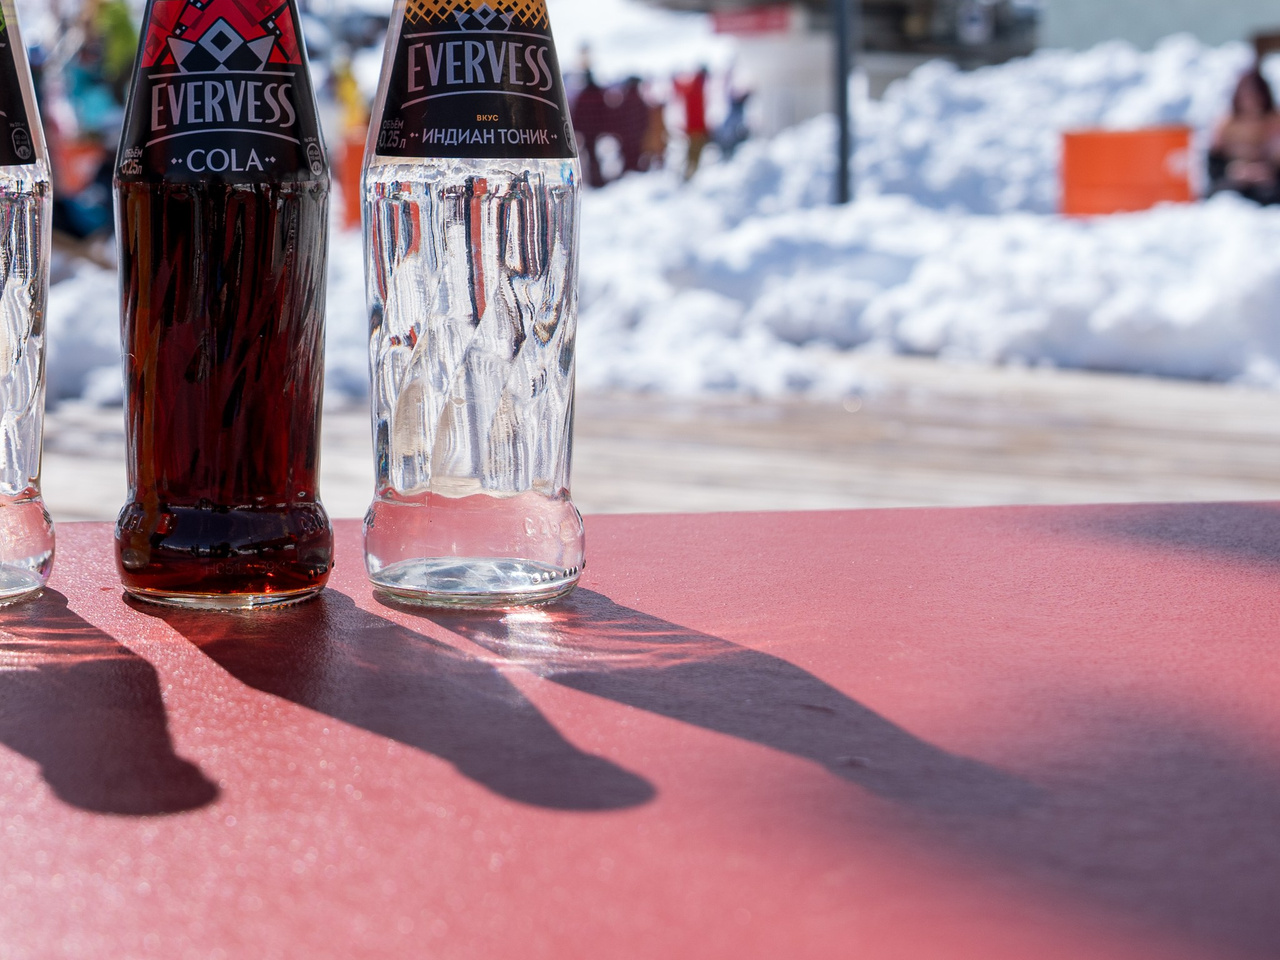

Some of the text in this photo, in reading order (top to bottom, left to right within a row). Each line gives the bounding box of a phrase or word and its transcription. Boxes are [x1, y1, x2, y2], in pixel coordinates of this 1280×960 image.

[407, 40, 553, 93] EVERVESS
[150, 80, 296, 132] EVERVESS
[476, 114, 499, 122] ВКУС
[422, 128, 550, 146] ИНДИАН ТОНИК
[186, 148, 264, 172] COLA
